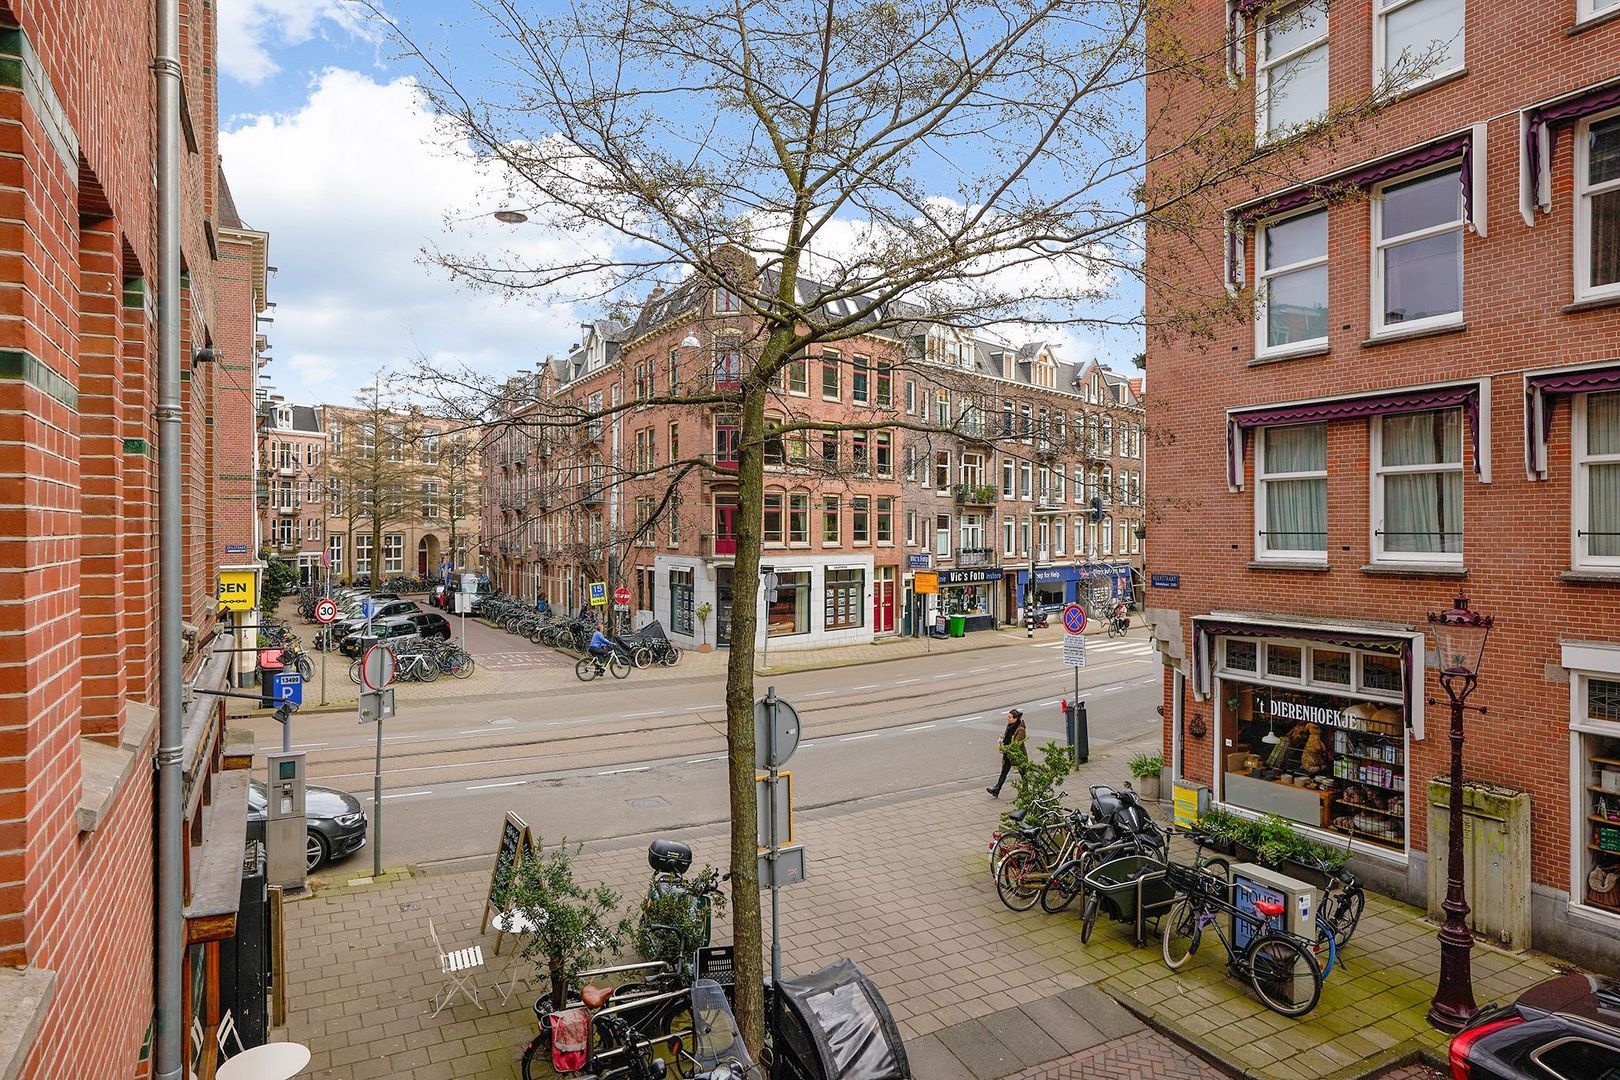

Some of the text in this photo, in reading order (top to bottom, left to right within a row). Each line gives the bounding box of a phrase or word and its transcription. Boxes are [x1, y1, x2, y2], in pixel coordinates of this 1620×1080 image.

[950, 571, 968, 582] Vic's
[970, 570, 985, 581] Foto
[320, 606, 334, 616] 30
[1256, 697, 1358, 730] 't DIERENHOEKJE
